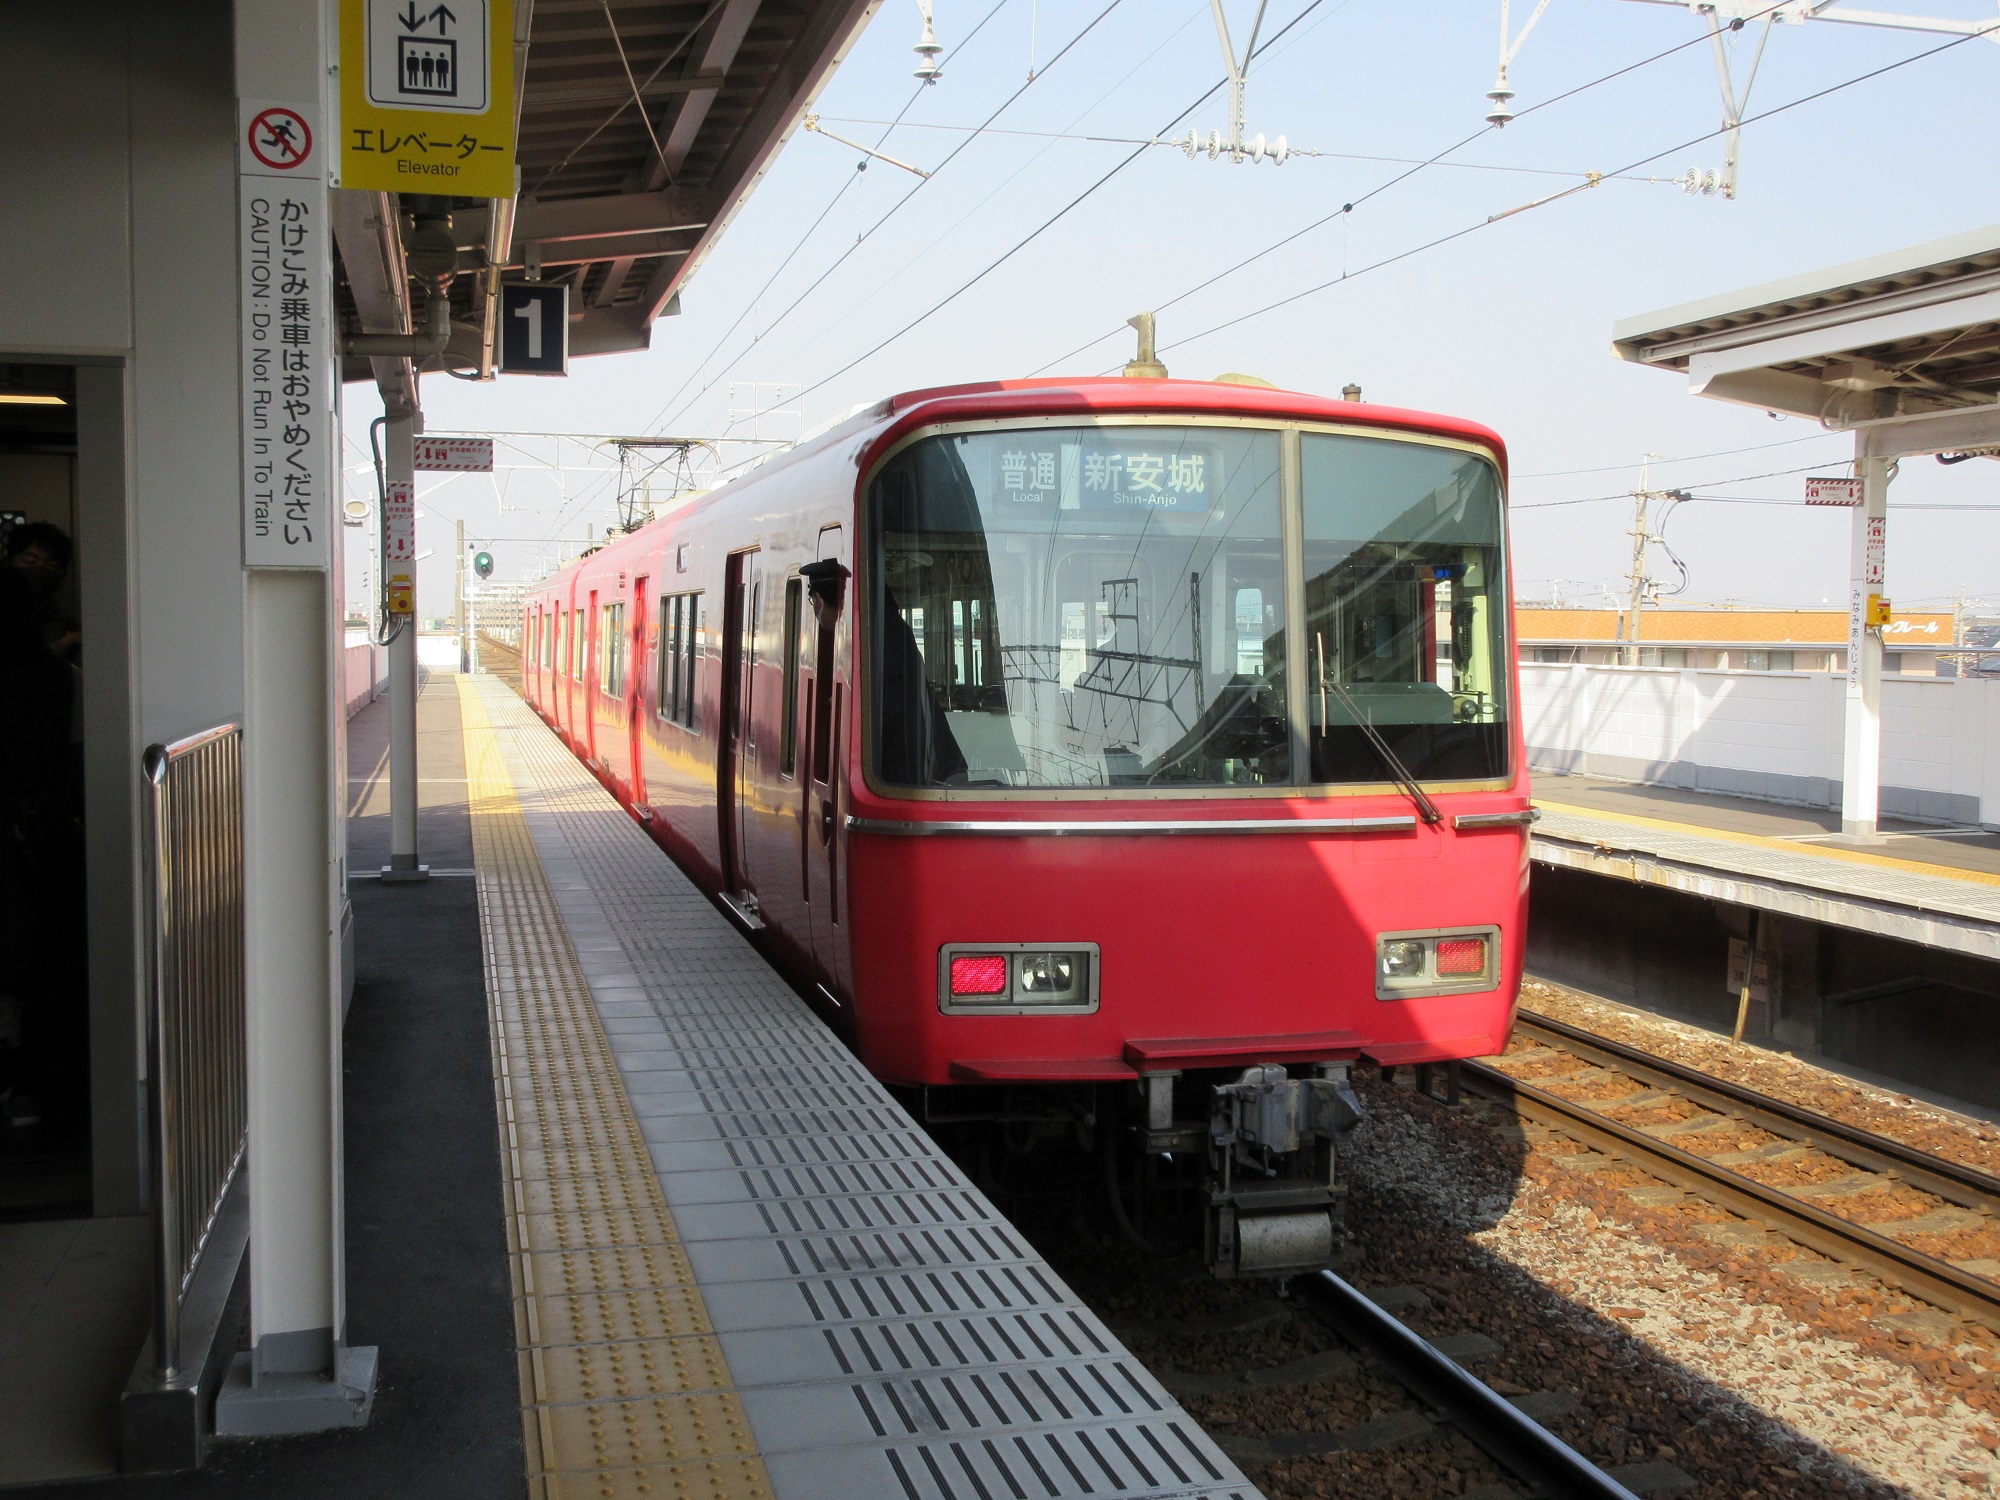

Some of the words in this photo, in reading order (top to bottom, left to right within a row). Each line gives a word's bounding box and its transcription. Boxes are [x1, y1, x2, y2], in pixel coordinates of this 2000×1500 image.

[352, 129, 504, 159] エレベーター
[397, 159, 460, 177] Elevator
[252, 313, 271, 341] Do
[514, 299, 542, 358] 1
[253, 349, 271, 383] Not
[280, 198, 313, 545] かけこみ乗車はおやめください
[253, 390, 272, 430] Run
[254, 438, 272, 455] In
[254, 461, 273, 484] To
[1001, 450, 1056, 490] 普通
[1085, 452, 1206, 494] 新安城
[255, 490, 273, 537] Train
[1013, 491, 1043, 503] Local
[1113, 493, 1177, 508] Shin-Anjo
[1851, 589, 1861, 689] みなみあんじょう
